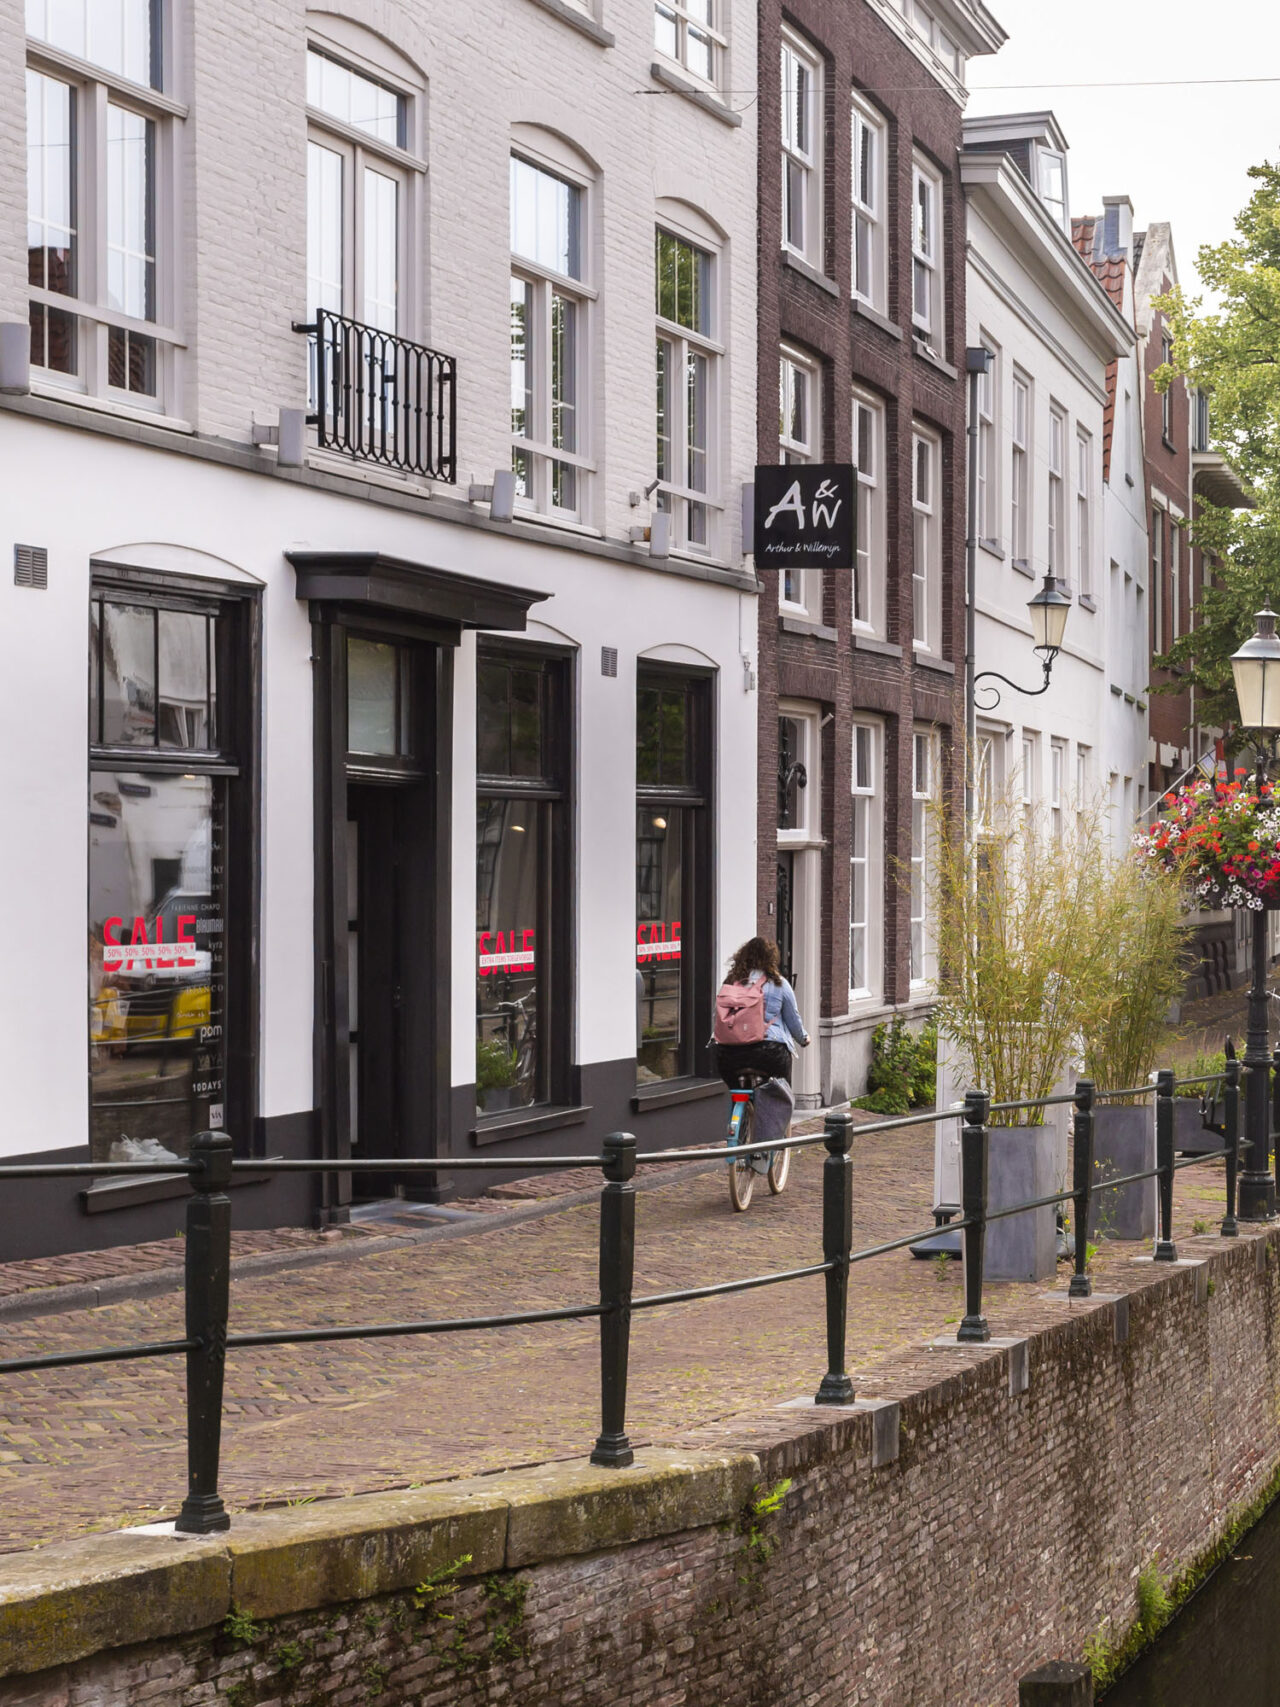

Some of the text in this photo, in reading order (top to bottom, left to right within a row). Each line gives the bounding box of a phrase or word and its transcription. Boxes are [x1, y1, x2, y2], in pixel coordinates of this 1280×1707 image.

[765, 541, 794, 553] Arthur
[795, 543, 801, 552] &
[103, 914, 196, 972] SALE
[479, 929, 535, 976] SALE
[636, 921, 681, 963] SALE
[200, 1025, 223, 1043] pom
[192, 1081, 222, 1093] 10DAYS
